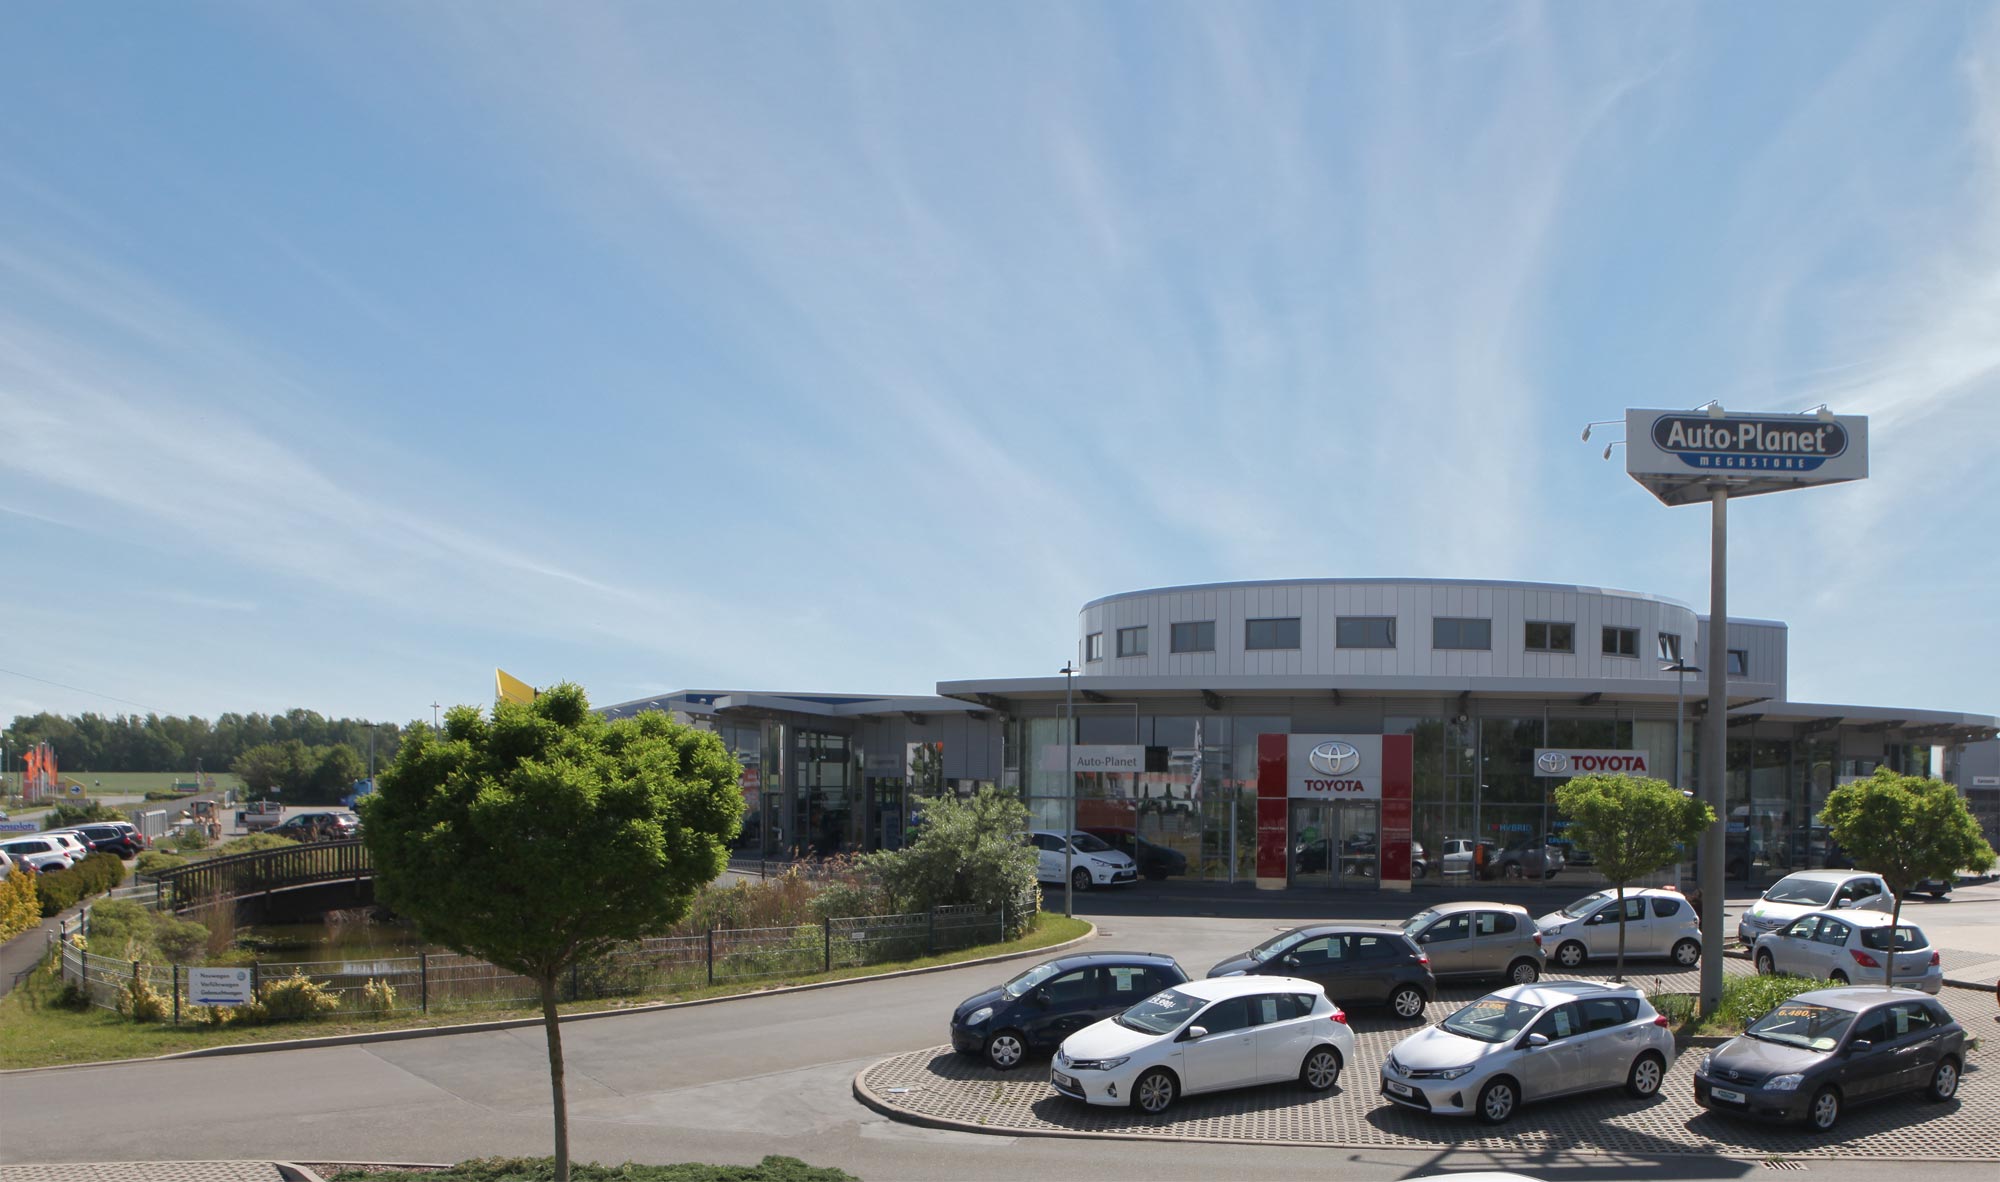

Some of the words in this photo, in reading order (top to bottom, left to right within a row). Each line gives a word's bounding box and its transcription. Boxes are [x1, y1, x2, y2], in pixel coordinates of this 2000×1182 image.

[1699, 456, 1805, 468] MEGASTORE
[1077, 756, 1137, 767] Auto-Planet
[1570, 755, 1647, 771] TOYOTA
[1304, 779, 1365, 792] TOYOTA
[1499, 823, 1533, 833] HYBRID
